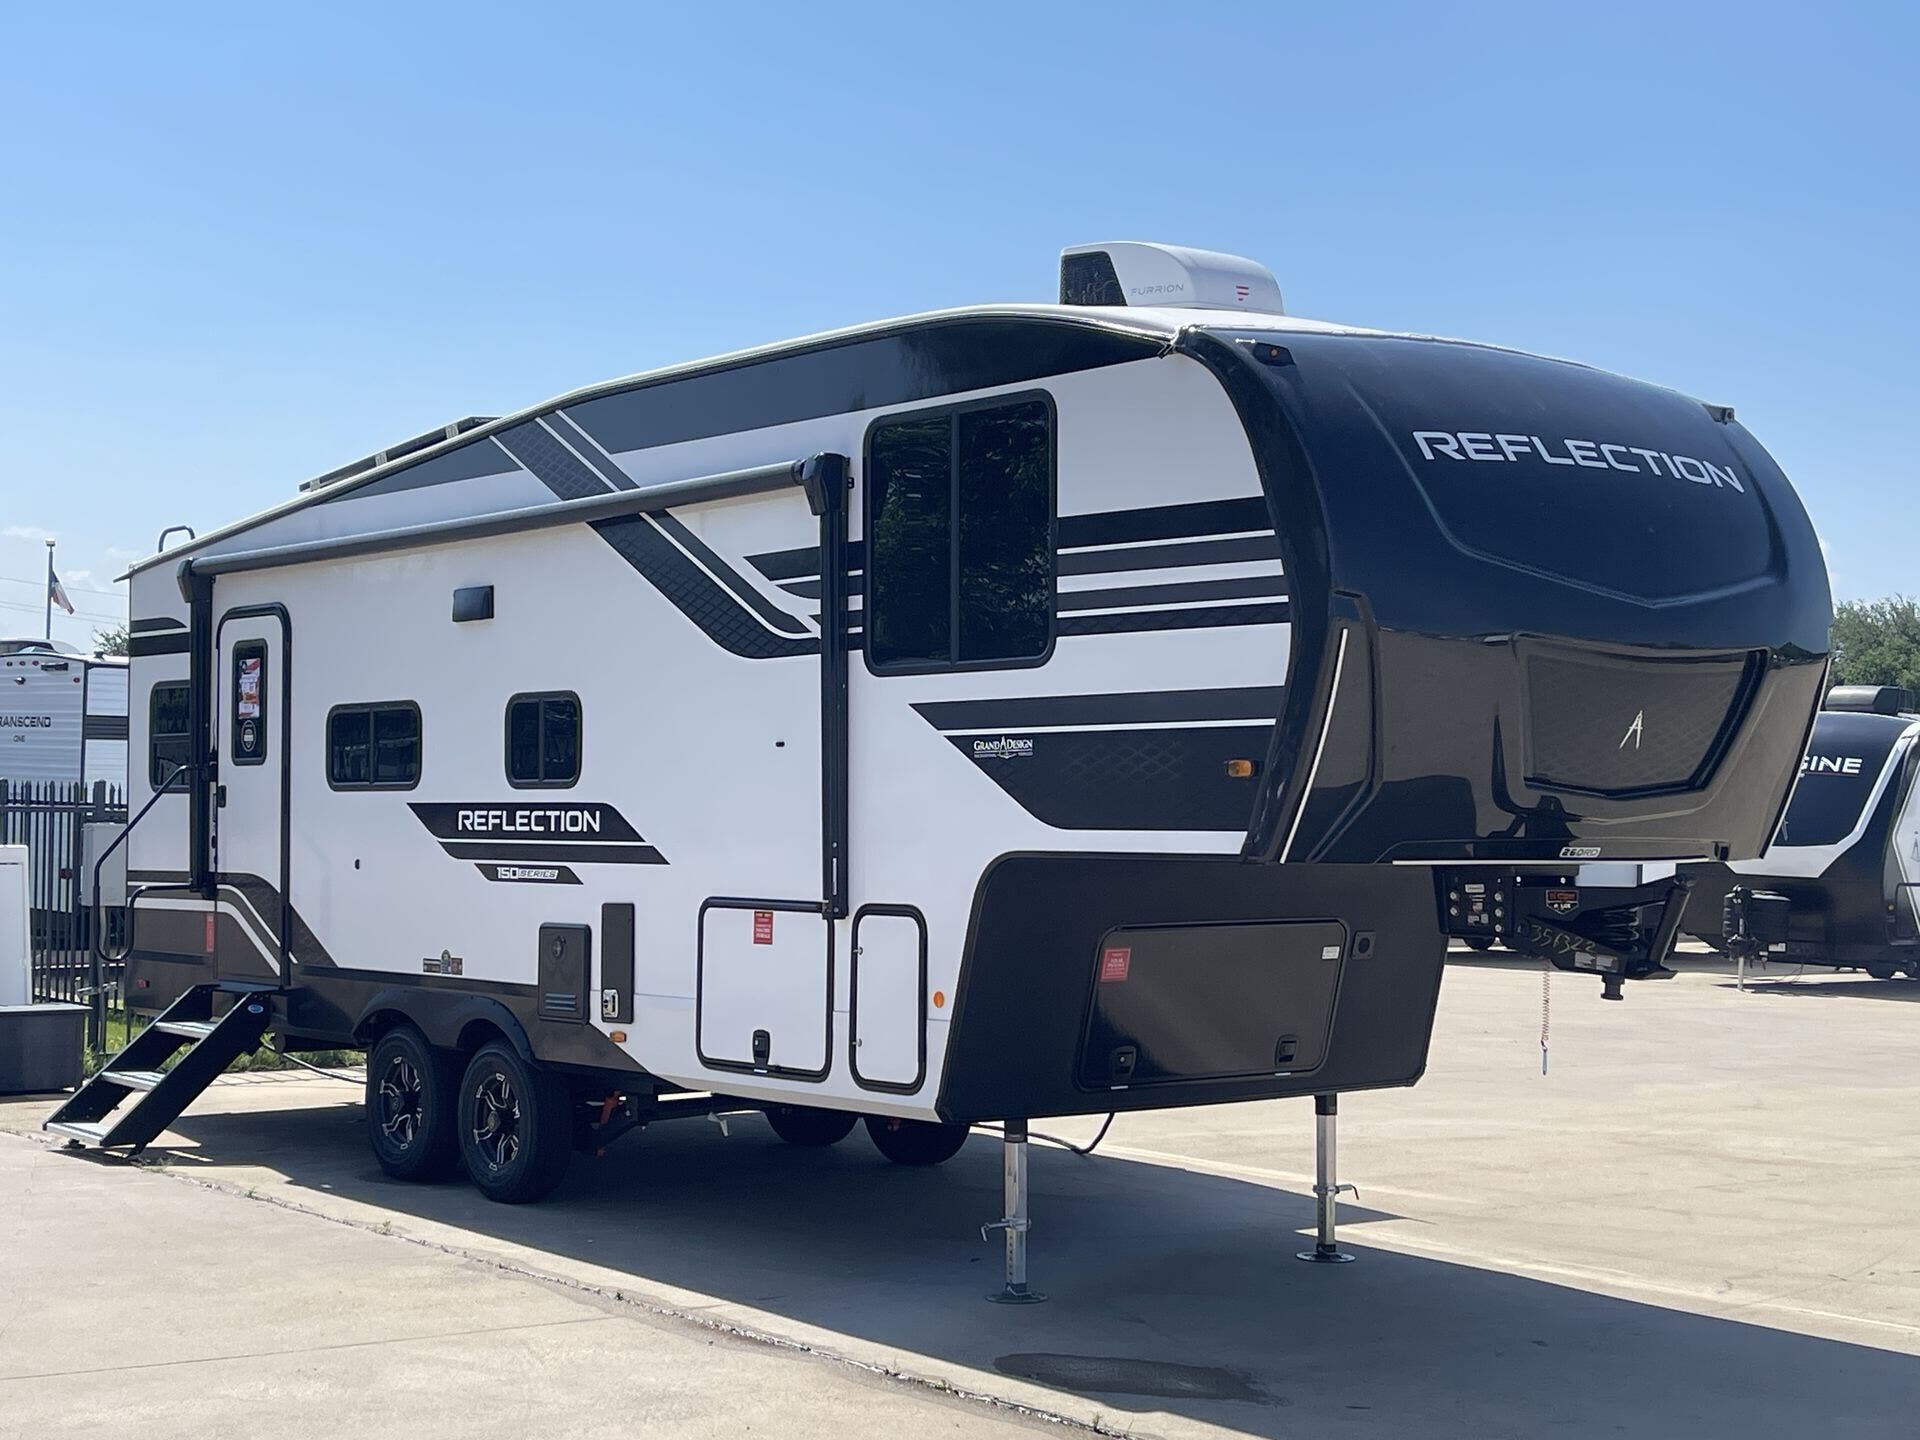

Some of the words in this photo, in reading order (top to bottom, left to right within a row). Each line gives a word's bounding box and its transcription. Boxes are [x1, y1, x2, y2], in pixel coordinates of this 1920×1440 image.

[1130, 283, 1184, 297] FURRION
[1412, 430, 1745, 494] REFLECTION
[973, 740, 1000, 751] GRAND
[1006, 738, 1033, 750] DESIGN
[457, 810, 601, 833] REFLECTION
